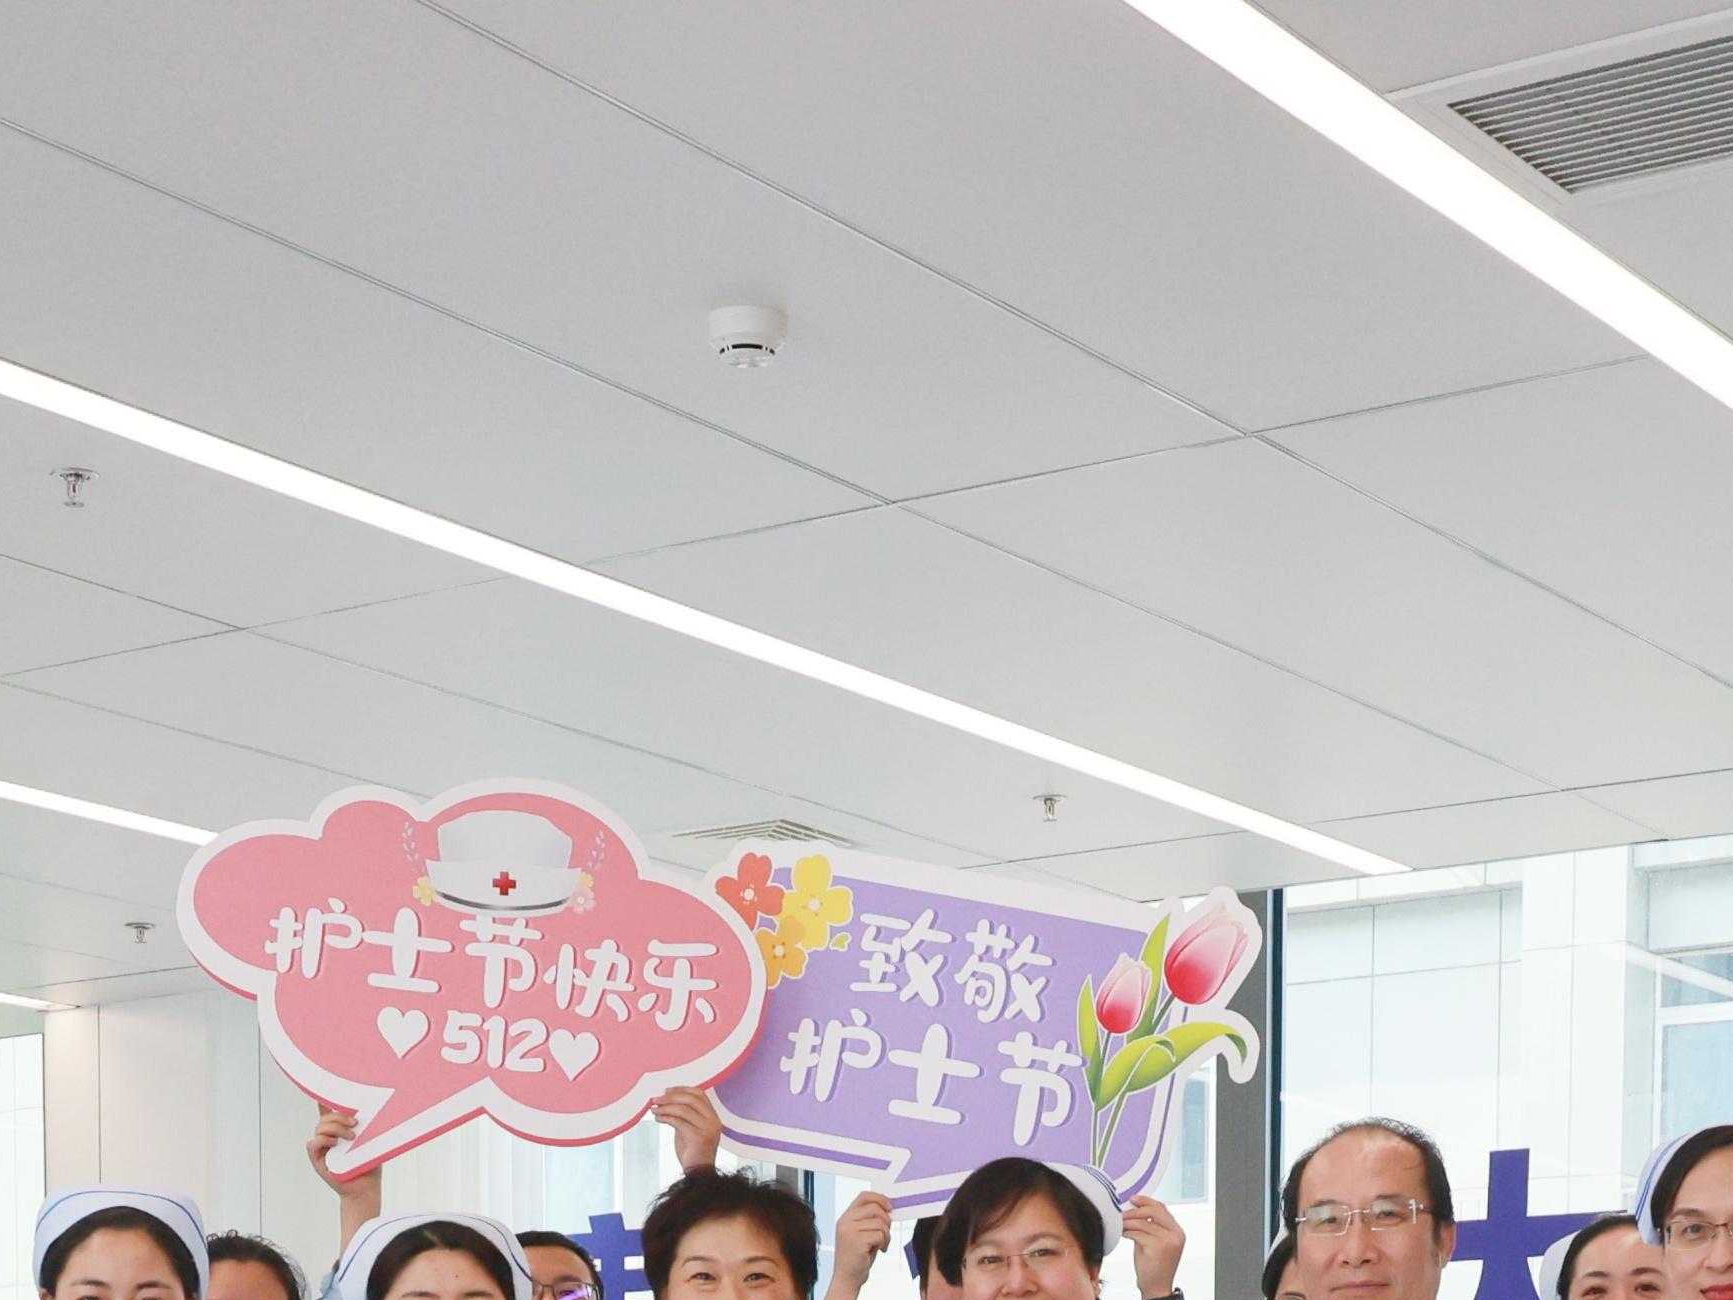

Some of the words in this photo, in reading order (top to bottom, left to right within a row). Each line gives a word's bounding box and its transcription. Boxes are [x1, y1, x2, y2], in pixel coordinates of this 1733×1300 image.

[266, 897, 720, 1030] 护士节快乐
[850, 908, 1055, 1023] 致敬
[443, 1015, 545, 1073] 512
[781, 1008, 1084, 1145] 护士节
